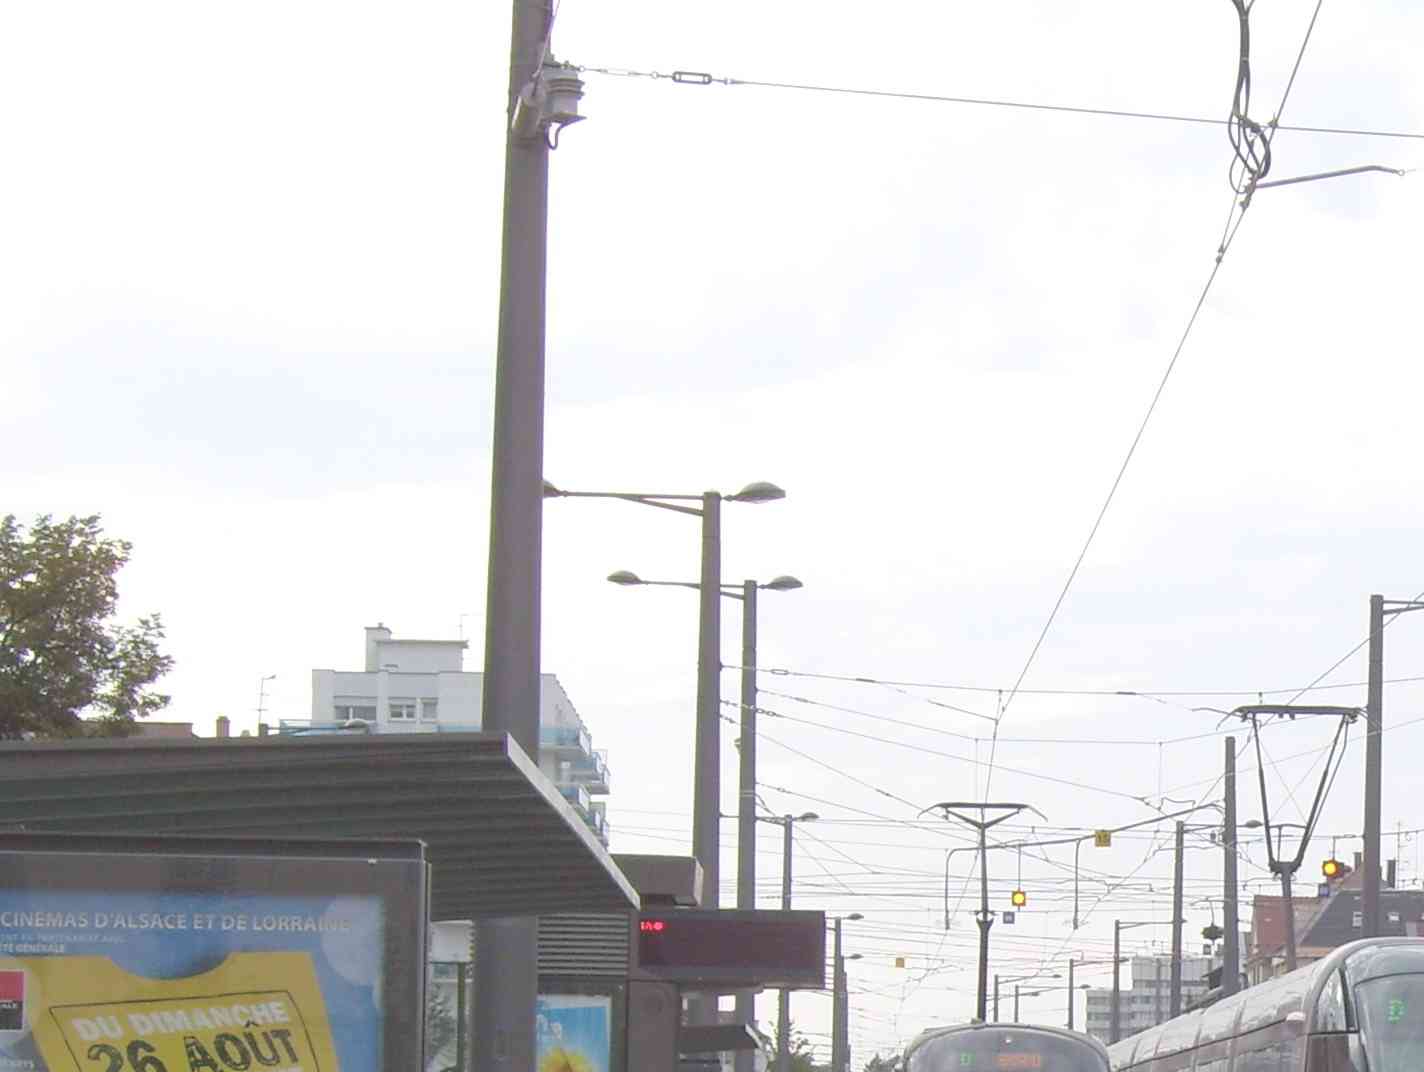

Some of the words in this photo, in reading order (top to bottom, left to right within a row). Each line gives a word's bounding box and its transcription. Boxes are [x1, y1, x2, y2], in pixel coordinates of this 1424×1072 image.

[95, 912, 187, 929] D'ALSACE
[192, 914, 213, 930] ET
[221, 914, 248, 931] DE
[72, 1015, 123, 1040] DU
[128, 1001, 289, 1035] DIMANCHE
